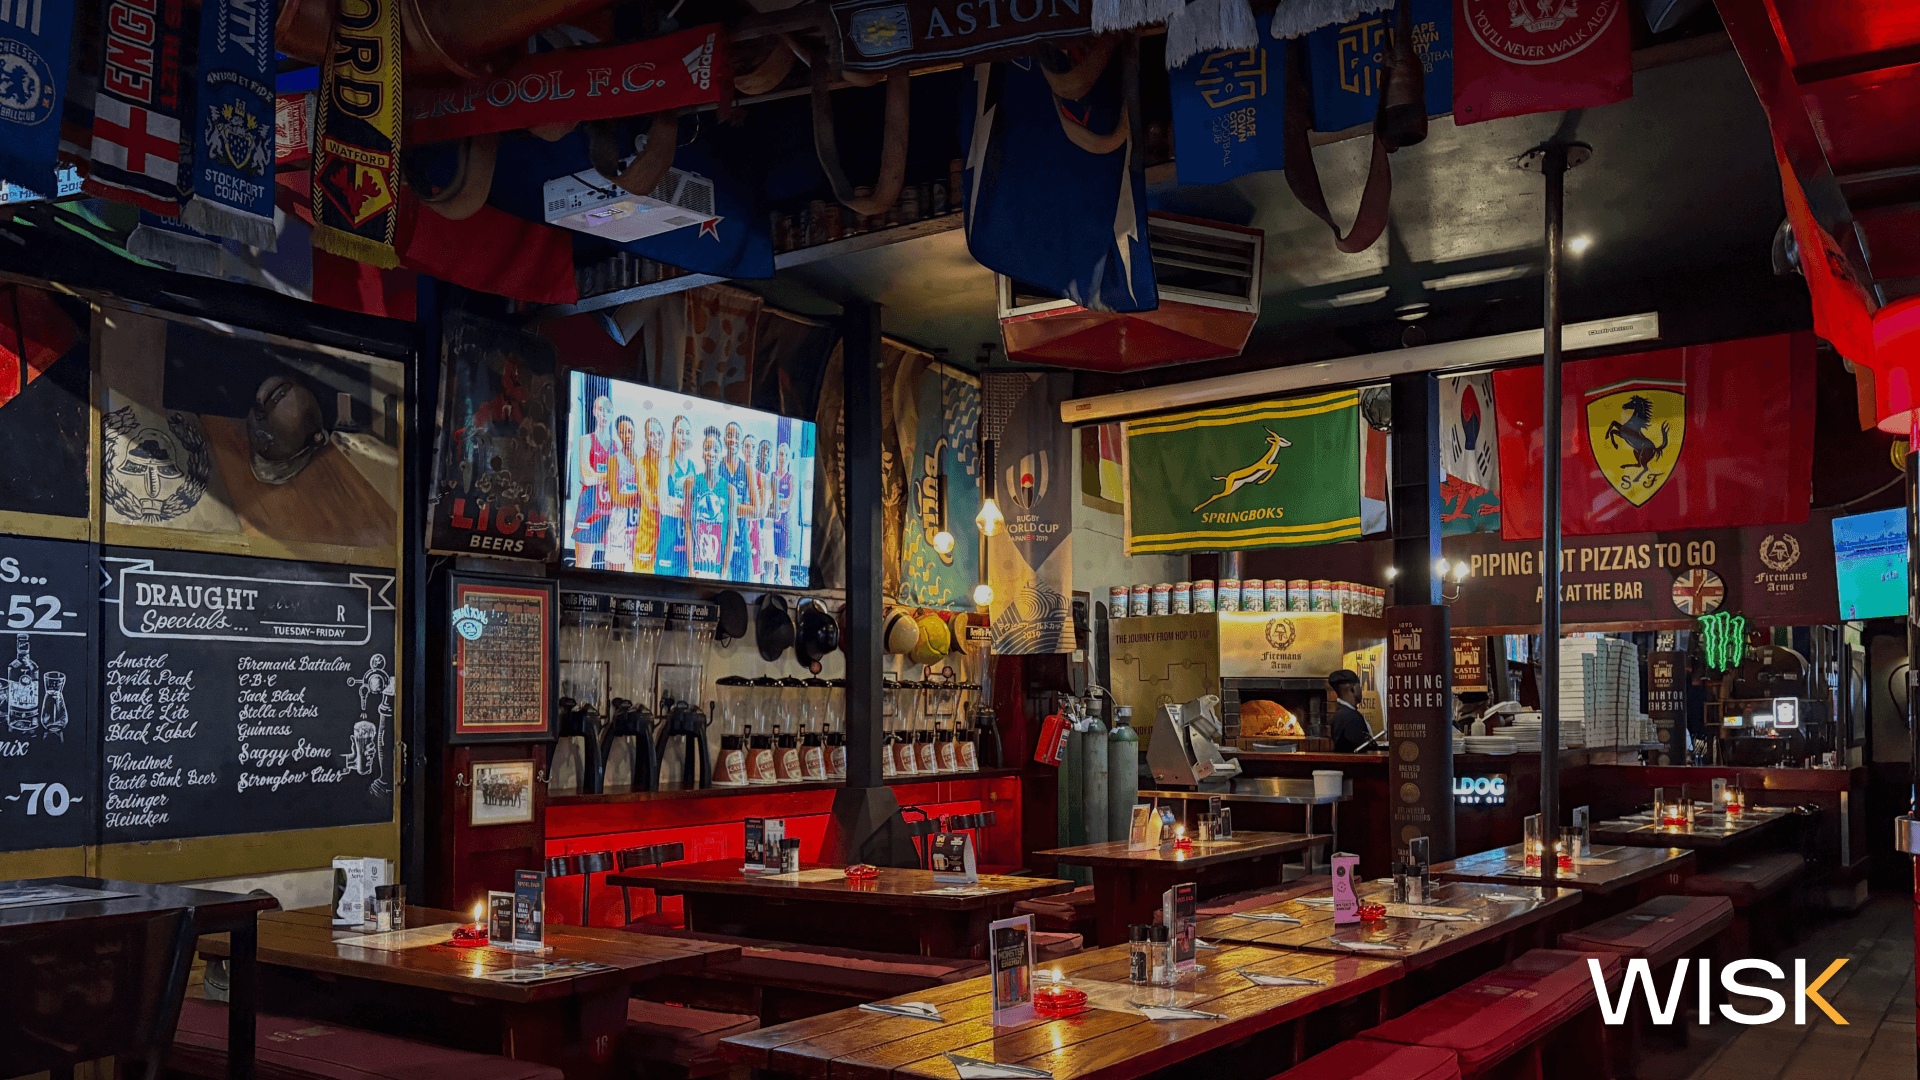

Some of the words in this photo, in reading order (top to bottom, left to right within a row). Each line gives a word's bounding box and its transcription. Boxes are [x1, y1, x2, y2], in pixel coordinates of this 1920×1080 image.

[924, 0, 1083, 40] ASTON
[1474, 9, 1505, 48] YOU'LL
[1504, 40, 1545, 57] NEVER
[1547, 29, 1588, 54] WALK
[699, 33, 716, 90] adidas
[1237, 108, 1248, 143] TOWN
[1247, 107, 1257, 137] CAPE
[329, 141, 386, 166] WATFORD
[204, 168, 265, 199] STOCKPORT
[214, 183, 255, 208] COUNTY
[1621, 475, 1632, 490] S
[1016, 514, 1040, 523] RUGBY
[1201, 507, 1284, 524] SPRINGBOKS
[1038, 523, 1060, 534] CUP
[469, 534, 525, 553] BEERS
[1470, 552, 1533, 578] PIPING
[1580, 544, 1651, 572] PIZZAS
[1655, 542, 1682, 568] TO
[1687, 540, 1716, 566] GO
[1754, 571, 1808, 583] Firemans
[135, 582, 258, 610] DRAUGHT
[1565, 584, 1583, 601] AT
[1584, 583, 1611, 600] THE
[1614, 581, 1643, 599] BAR
[1767, 583, 1795, 592] Arms
[579, 594, 597, 606] Peak
[636, 600, 654, 612] Peak
[337, 604, 346, 622] R
[691, 605, 709, 616] Peak
[1116, 634, 1127, 644] THE
[1128, 632, 1155, 643] JOURNEY
[1156, 632, 1174, 642] FROM
[1175, 631, 1189, 641] HOP
[107, 651, 169, 669] Amstel
[238, 656, 296, 671] Fireman's
[298, 655, 352, 672] Battalion
[1261, 651, 1302, 660] Firemans
[1393, 653, 1423, 661] CASTLE
[1271, 661, 1292, 670] Arms
[154, 669, 195, 691] Peak
[109, 685, 153, 705] Snake
[157, 687, 190, 704] Bite
[237, 689, 268, 704] Jack
[271, 687, 306, 703] Black
[1357, 697, 1376, 710] ASTLE
[109, 703, 155, 721] Castle
[158, 702, 190, 724] Lite
[238, 704, 278, 721] Stella
[278, 702, 319, 718] Artois
[105, 723, 151, 745] Black
[152, 721, 199, 744] Label
[237, 720, 292, 742] Guinness
[107, 752, 173, 771] Windhoek
[238, 742, 290, 768] Saggy
[291, 738, 332, 762] Stone
[108, 773, 147, 791] Castle
[150, 768, 183, 788] Tank
[187, 769, 217, 785] Beer
[237, 769, 309, 793] Strongbow
[310, 766, 344, 783] Cider
[105, 791, 170, 813] Erdinger
[105, 811, 170, 828] Heineken
